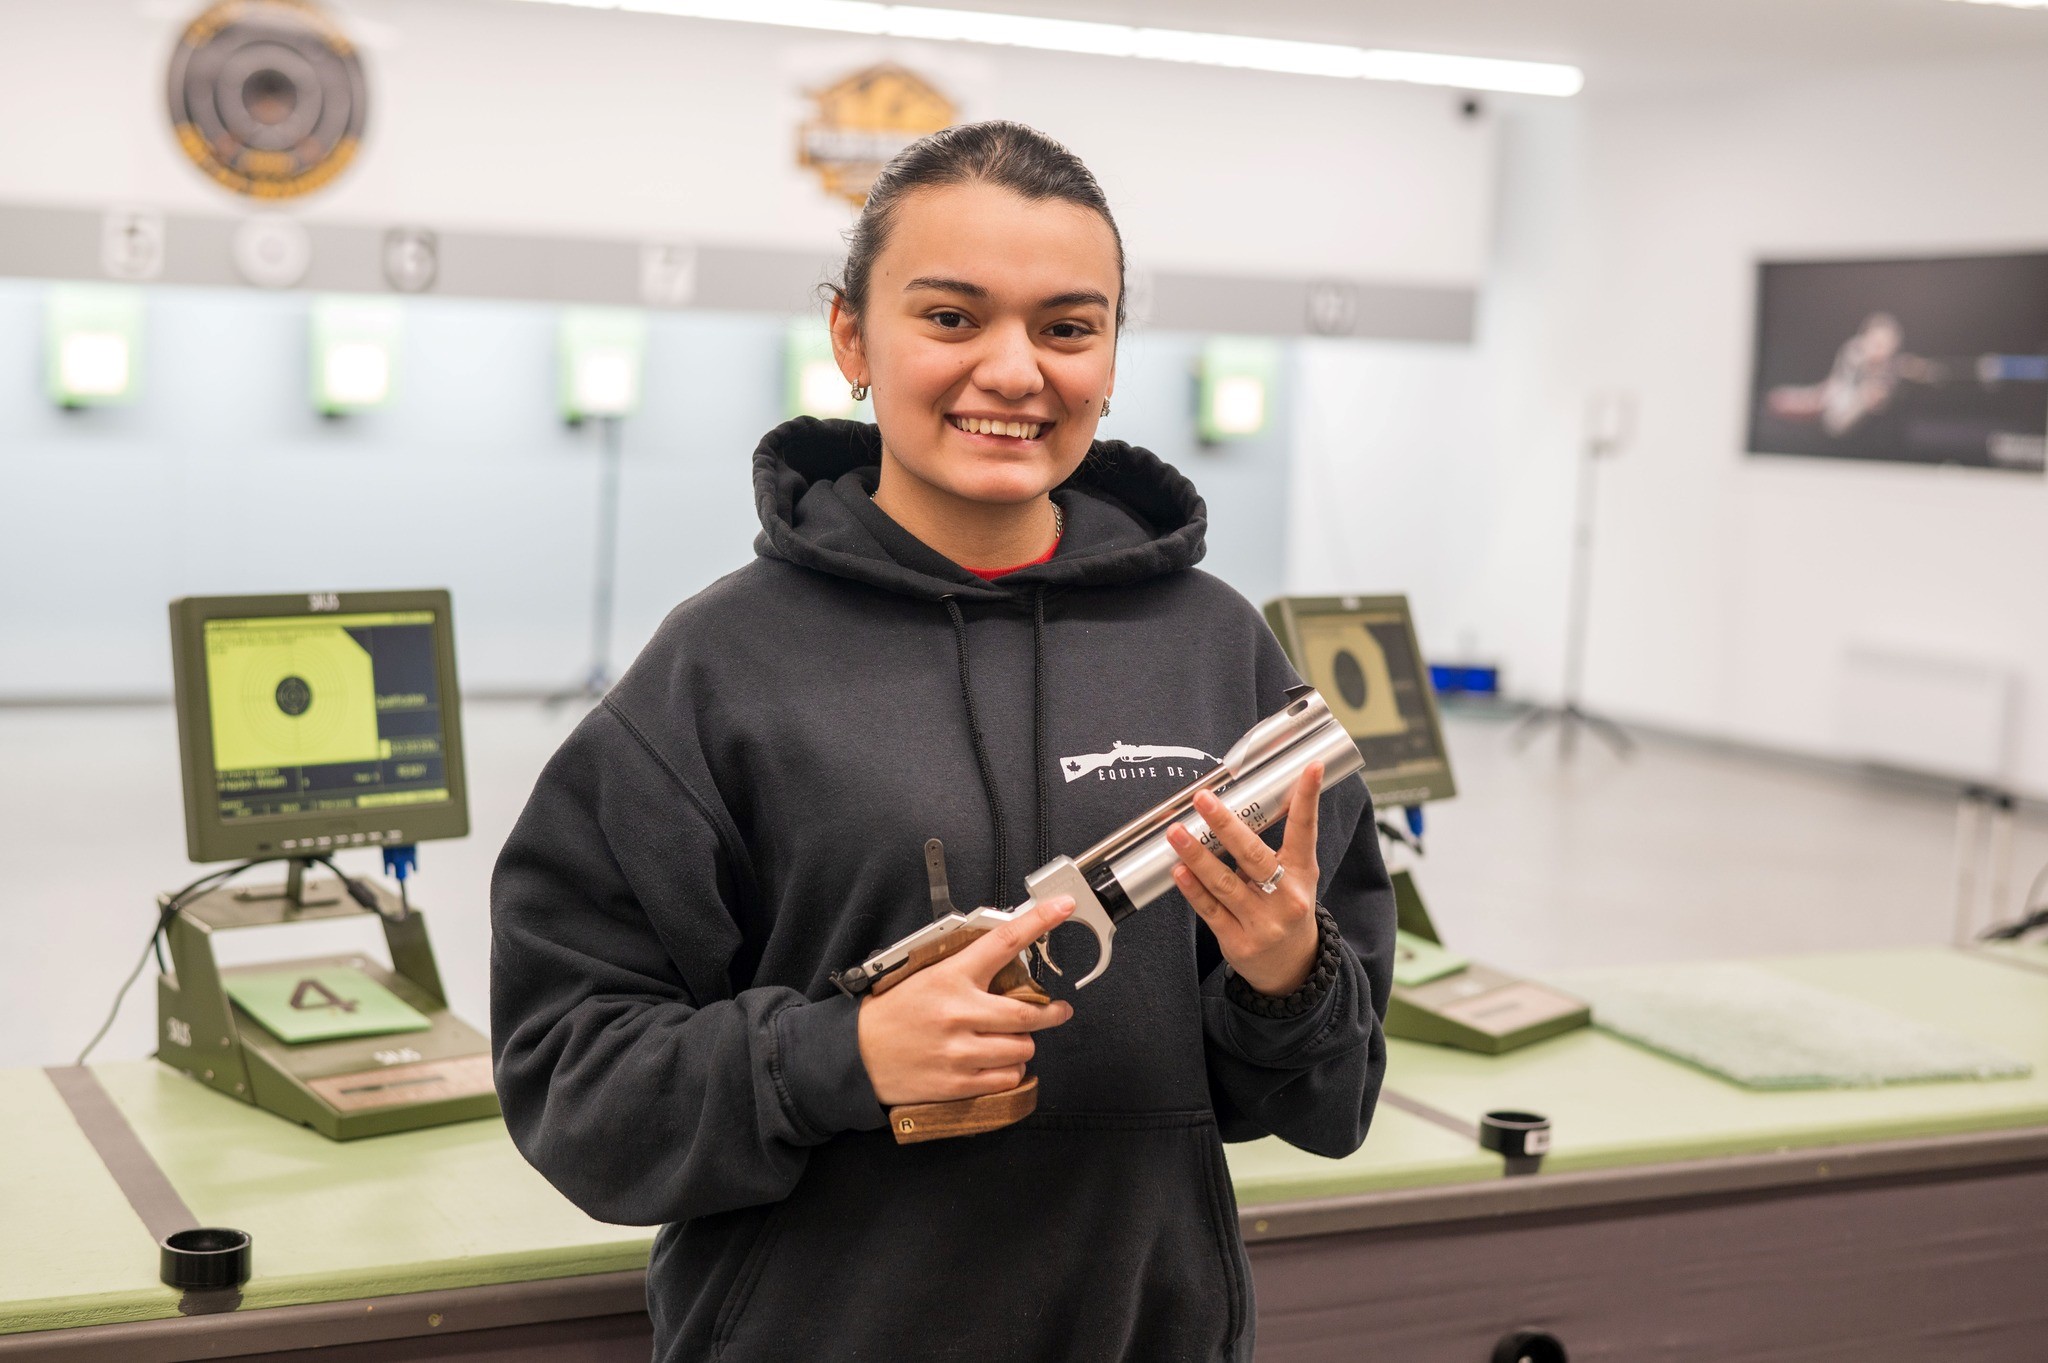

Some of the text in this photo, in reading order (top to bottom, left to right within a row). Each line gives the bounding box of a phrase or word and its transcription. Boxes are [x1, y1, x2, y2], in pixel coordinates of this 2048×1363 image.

[1098, 766, 1185, 781] ÉQUIPE DE
[289, 978, 361, 1013] 4
[901, 1120, 912, 1131] R
